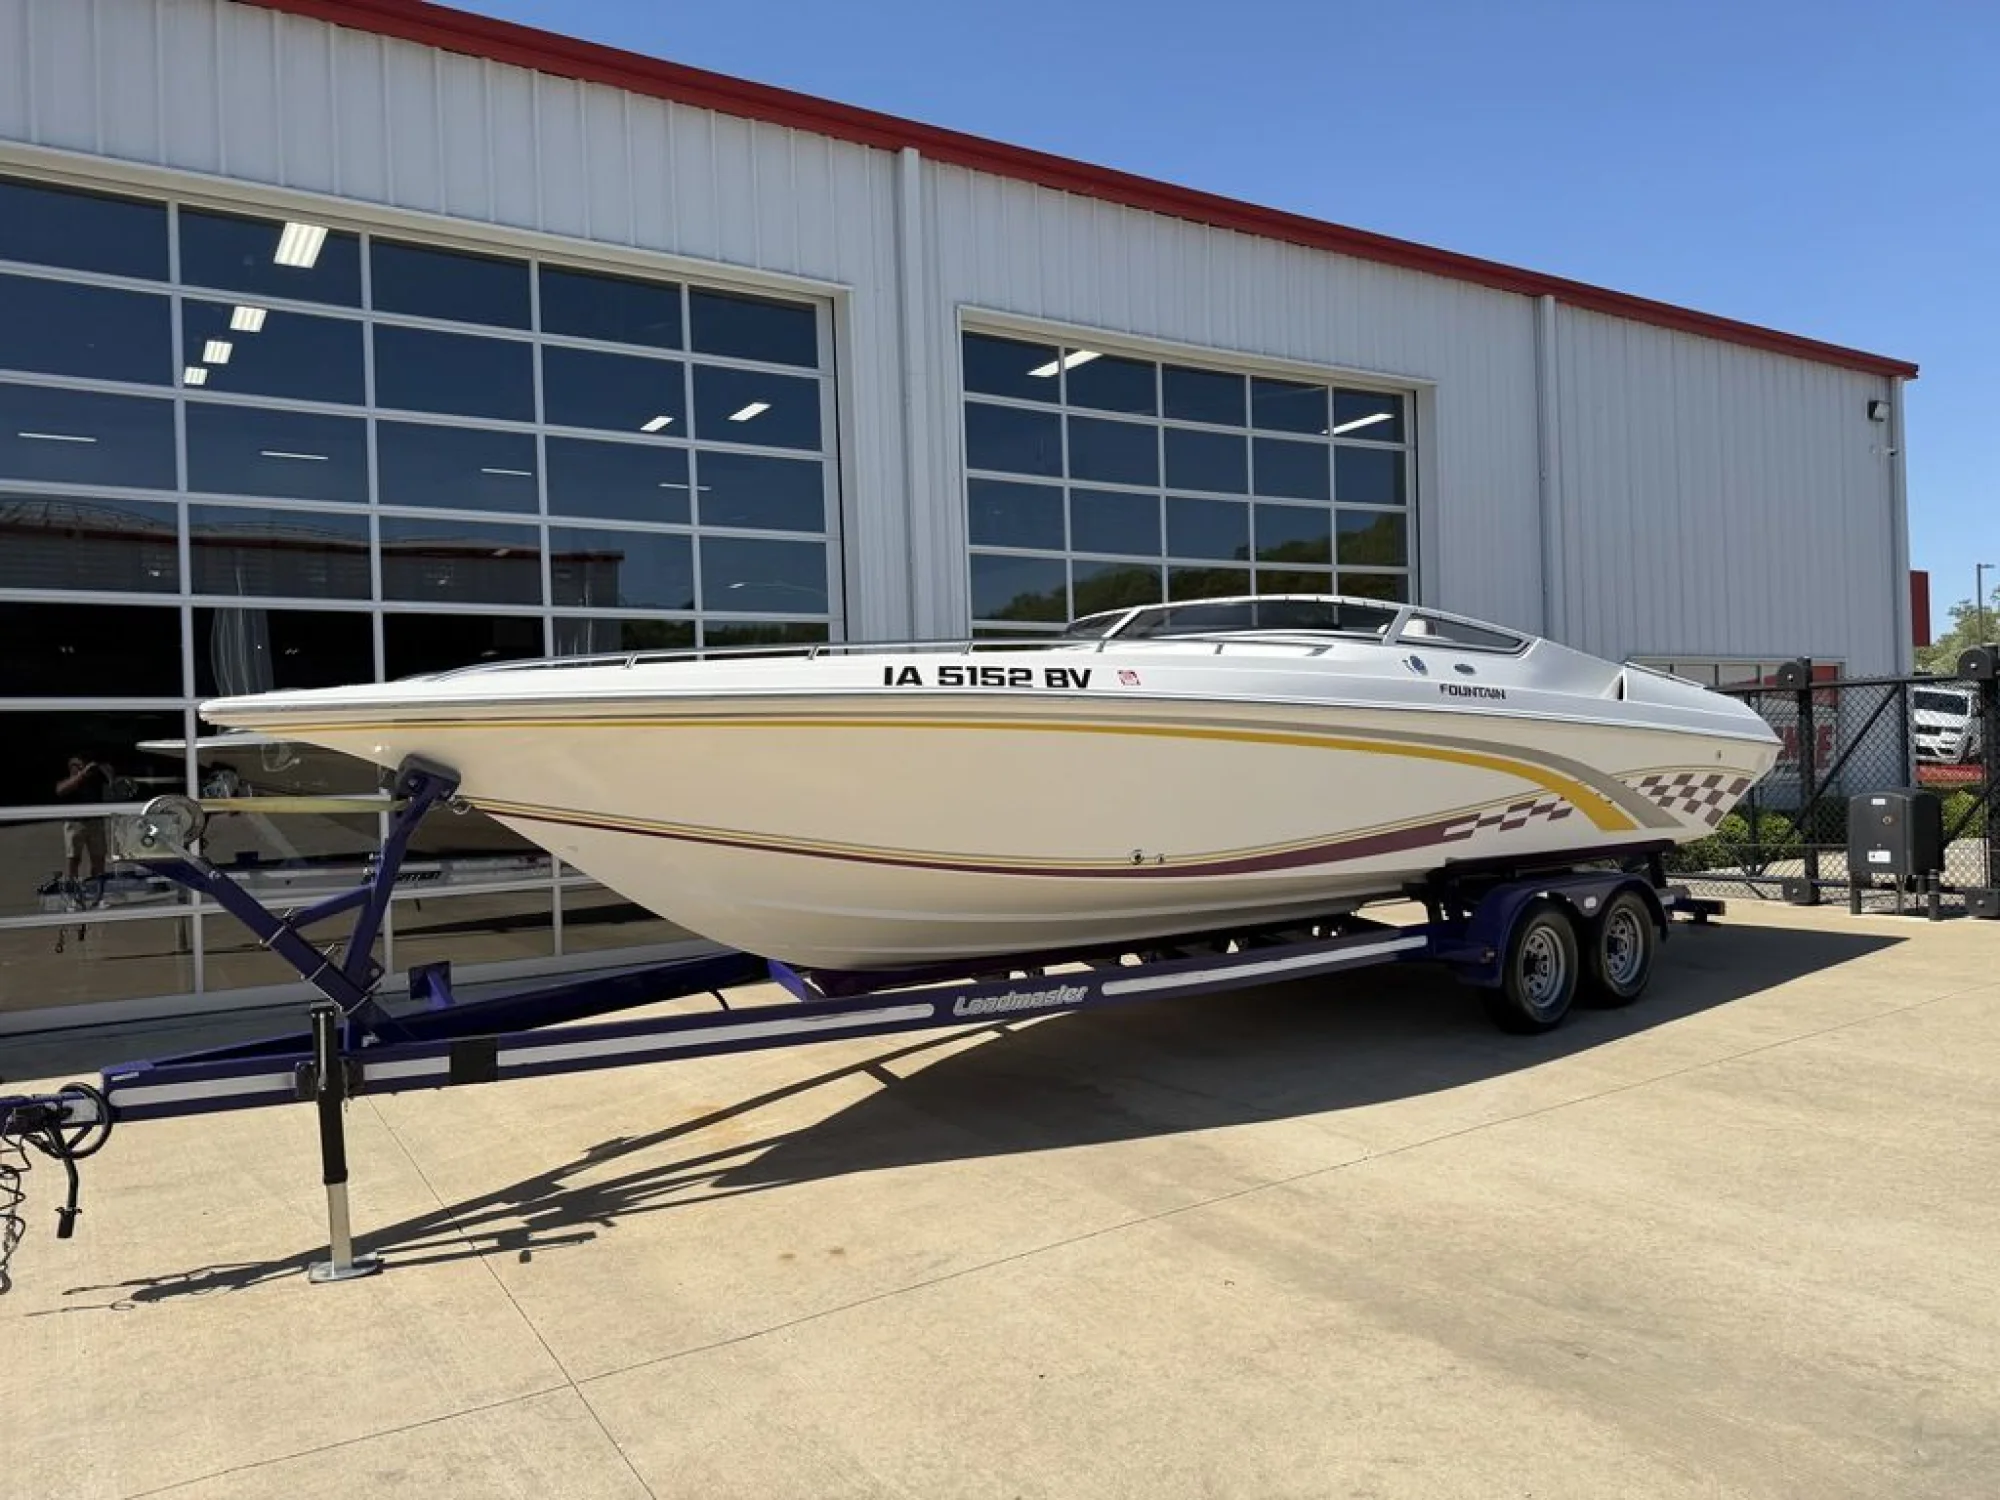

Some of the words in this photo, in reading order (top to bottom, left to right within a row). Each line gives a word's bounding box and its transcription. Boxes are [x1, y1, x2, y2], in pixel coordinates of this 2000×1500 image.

[884, 666, 922, 686] IA
[937, 666, 1033, 688] 5152
[1044, 668, 1092, 688] BV
[1438, 683, 1507, 700] FOUNTAIN
[953, 985, 1089, 1017] Loadmaster
